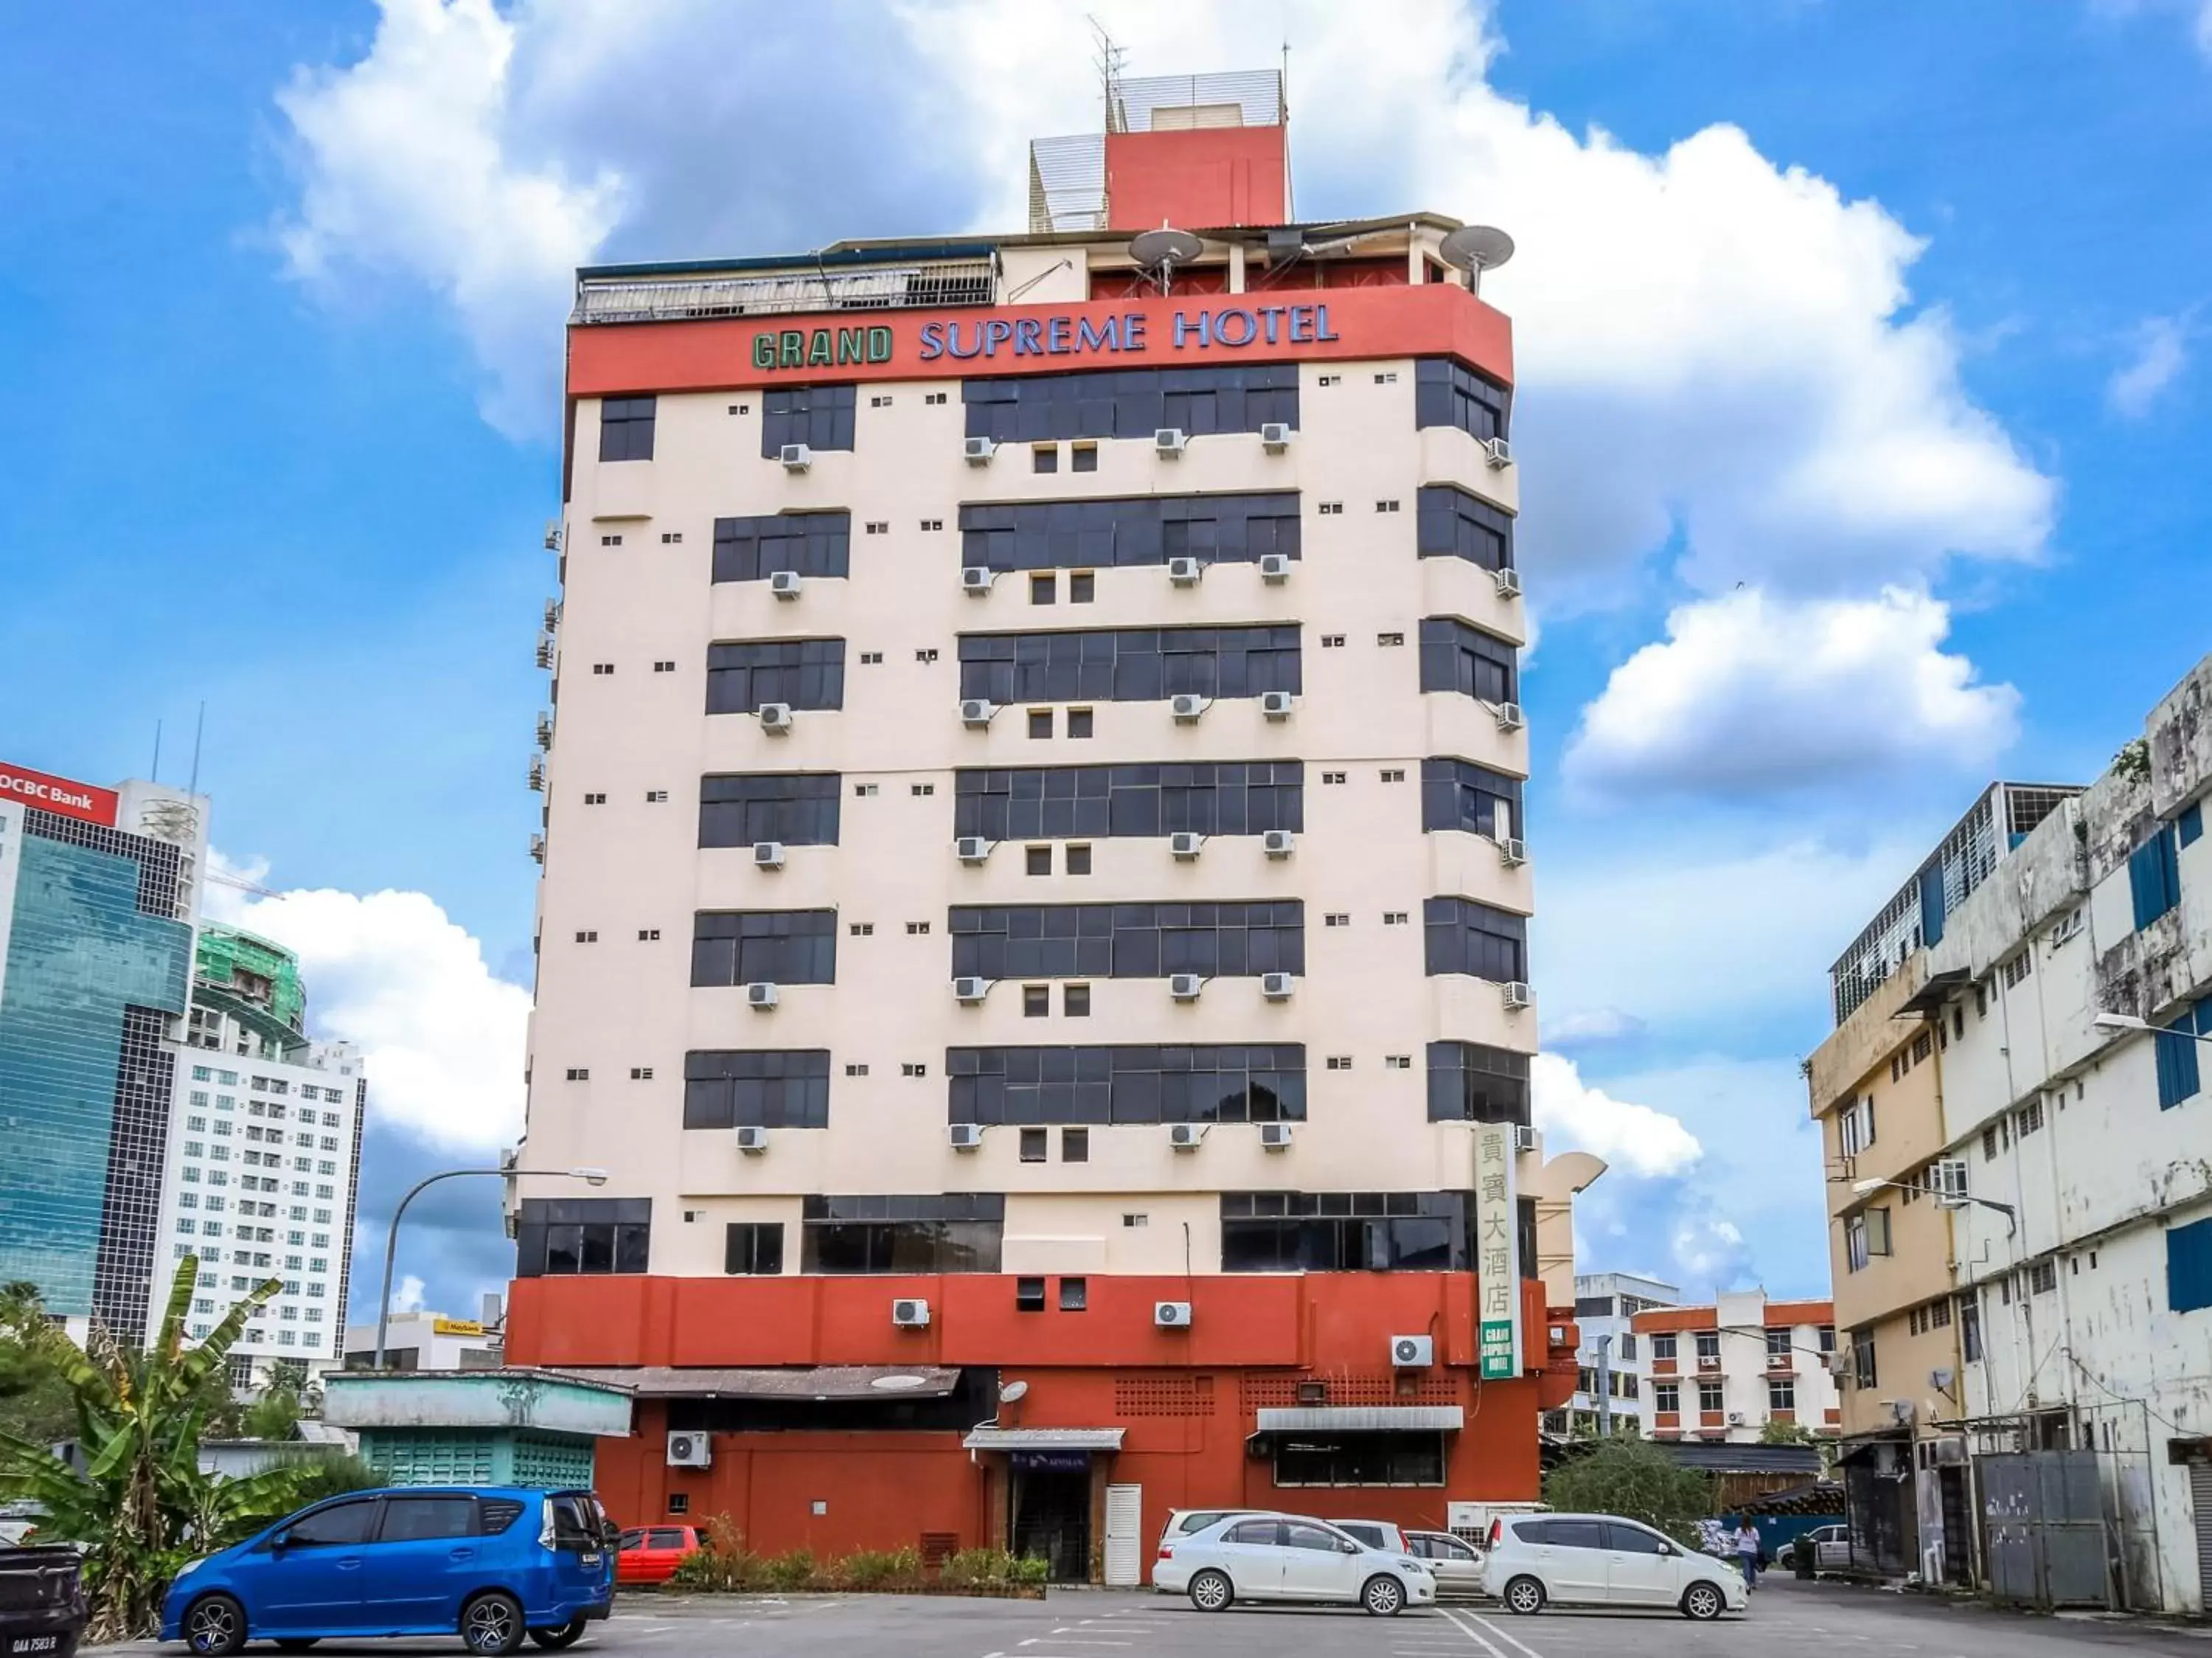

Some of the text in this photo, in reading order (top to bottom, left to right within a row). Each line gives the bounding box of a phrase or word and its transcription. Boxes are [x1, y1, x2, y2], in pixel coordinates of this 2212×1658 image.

[753, 304, 1339, 370] GRAND SUPREME HOTEL
[0, 774, 93, 810] OCBC Bank
[1481, 1132, 1509, 1315] 貴賓大酒店
